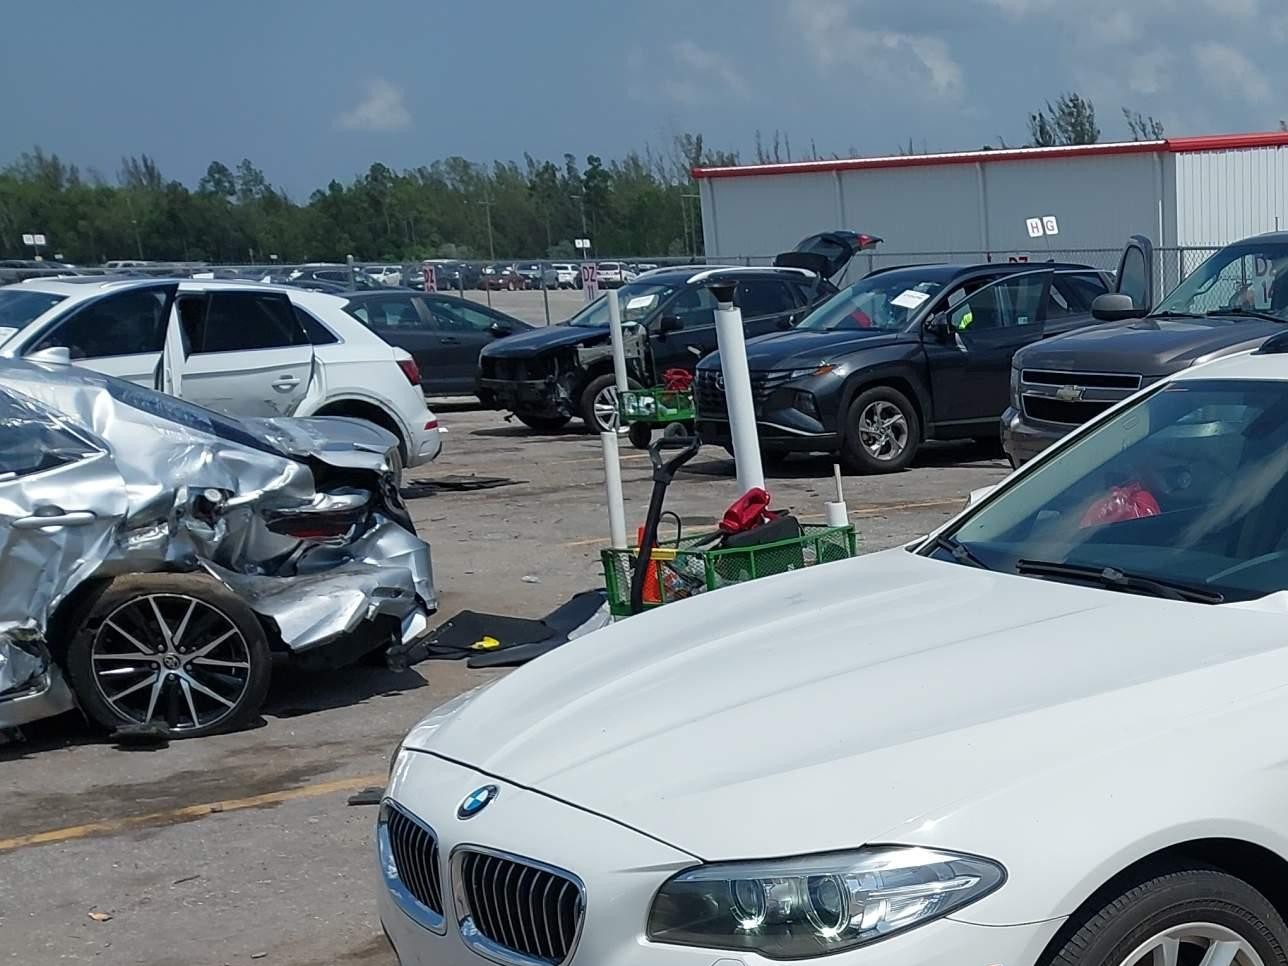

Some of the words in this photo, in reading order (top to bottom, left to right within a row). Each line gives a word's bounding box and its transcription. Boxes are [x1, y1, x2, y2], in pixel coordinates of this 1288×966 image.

[1030, 222, 1040, 234] H
[1045, 220, 1055, 232] G
[582, 266, 596, 282] DZ
